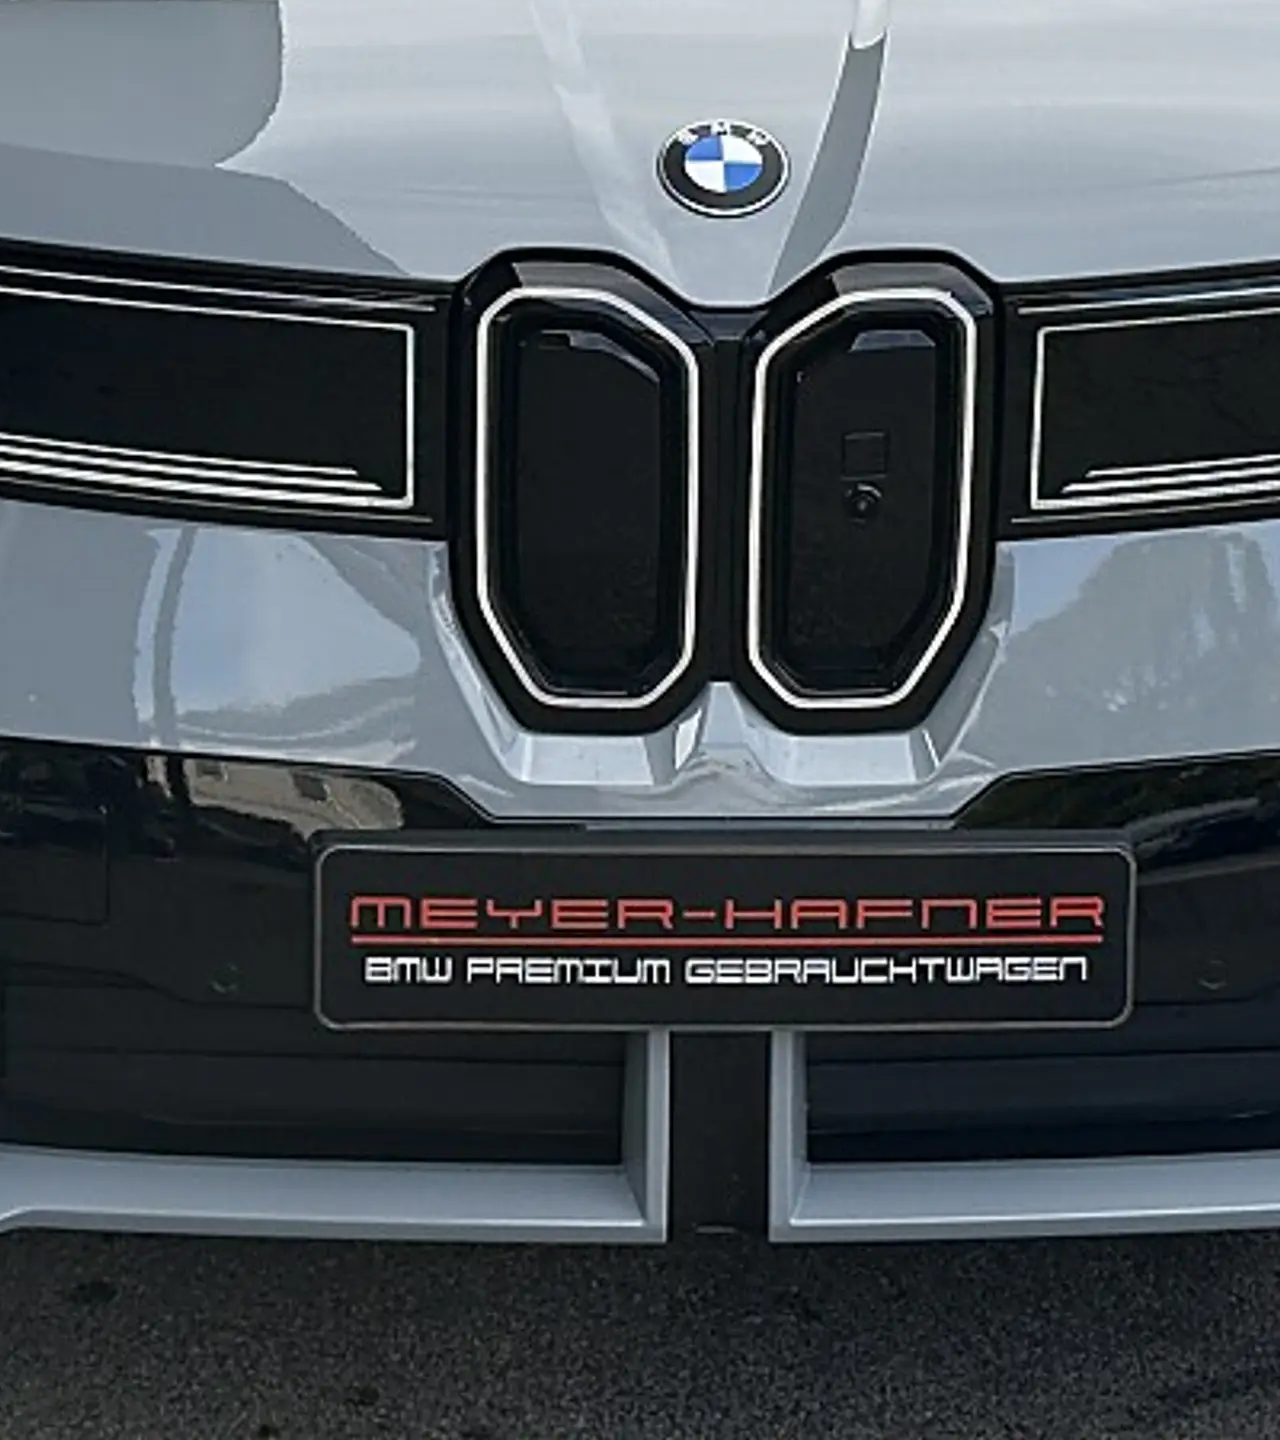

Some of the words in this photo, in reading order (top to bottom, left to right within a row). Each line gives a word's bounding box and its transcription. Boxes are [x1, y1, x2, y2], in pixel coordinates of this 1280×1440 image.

[351, 895, 1104, 928] MEYER-HAFNER
[365, 956, 452, 984] BMW
[466, 956, 671, 985] PREMIUM
[684, 955, 1088, 984] GEBRAUCHTWAGEN
